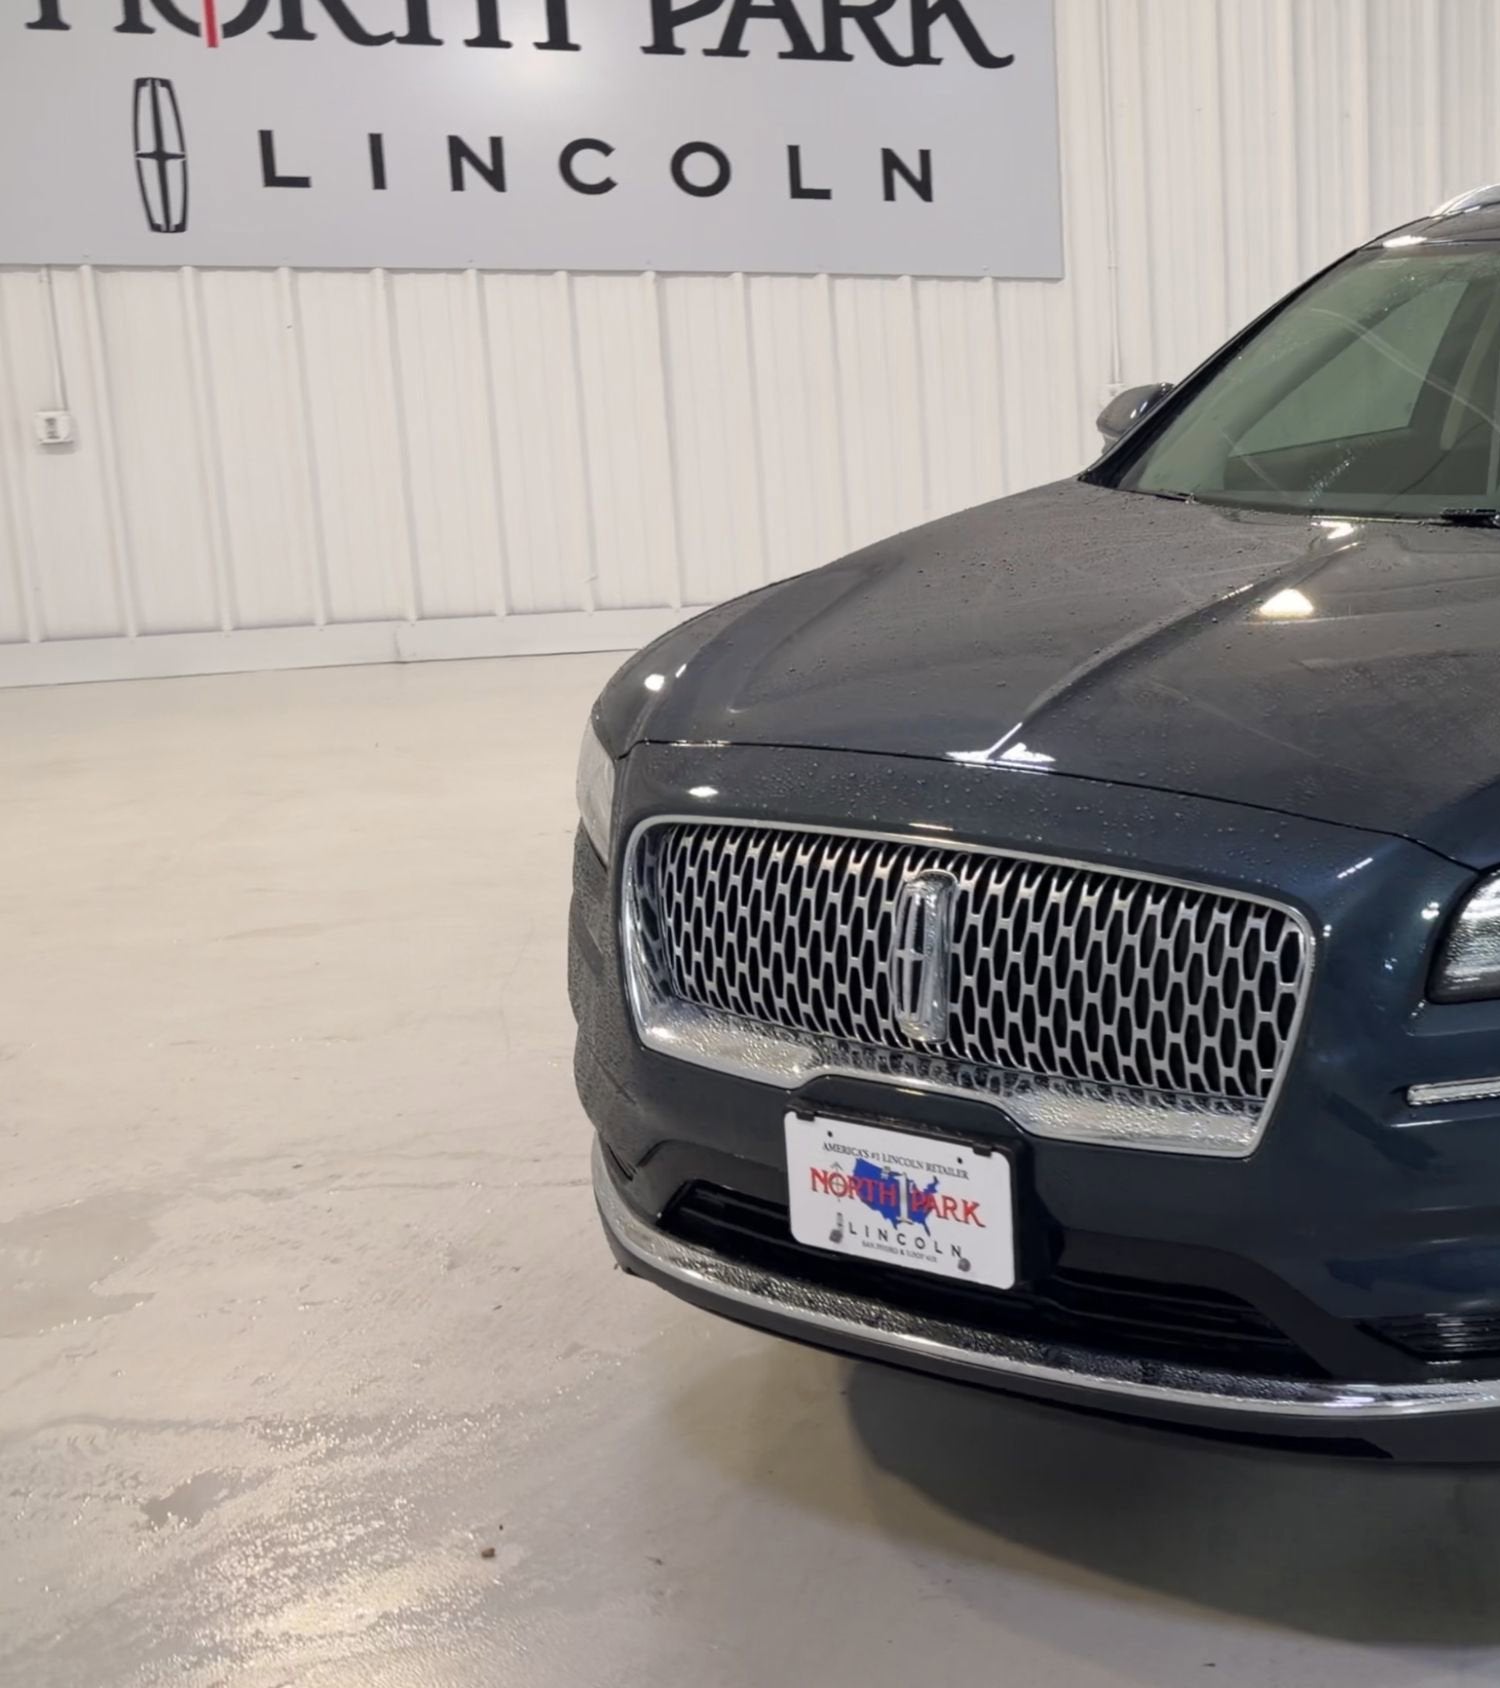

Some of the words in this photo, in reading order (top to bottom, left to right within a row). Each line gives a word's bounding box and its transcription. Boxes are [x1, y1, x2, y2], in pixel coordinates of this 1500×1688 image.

[258, 129, 934, 203] LINCOLN
[881, 1153, 924, 1170] LINCOLN
[925, 1162, 969, 1180] RETAILER
[810, 1167, 898, 1207] NORTH
[911, 1184, 986, 1228] PARK
[849, 1221, 962, 1258] LINCOLN
